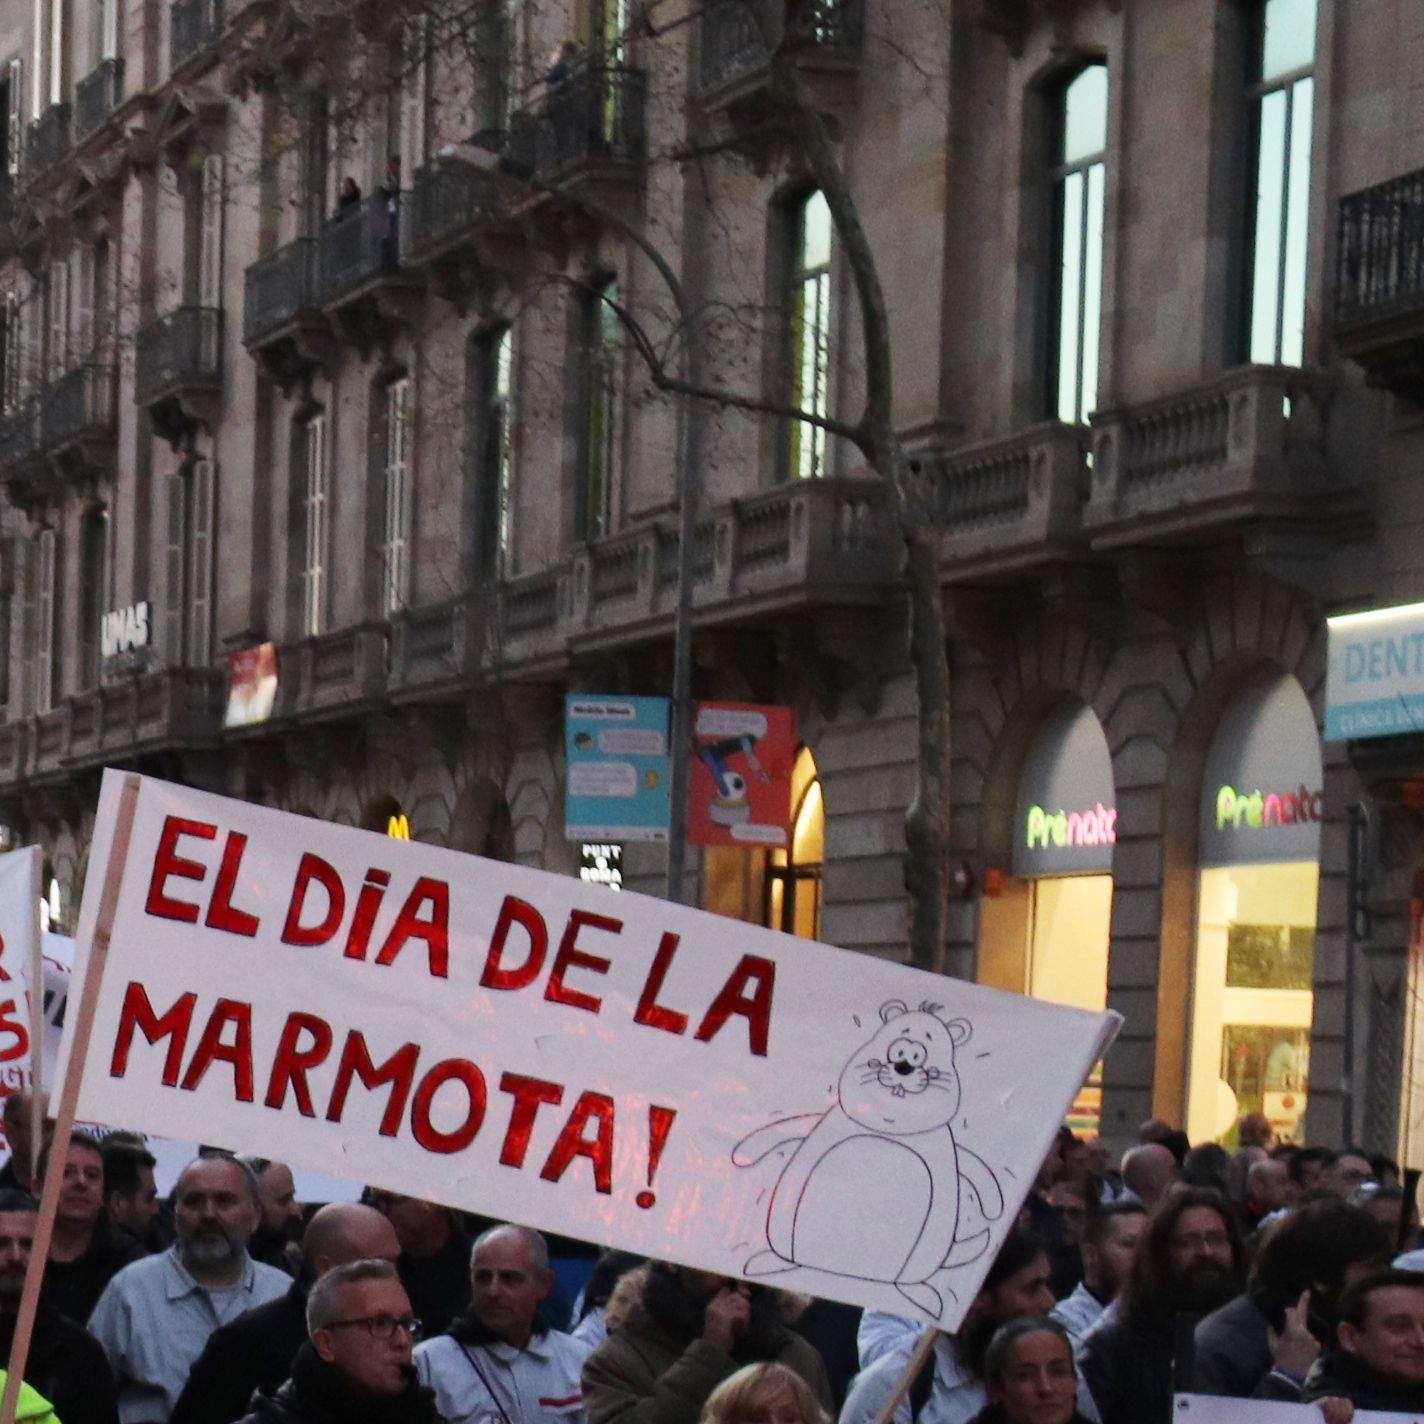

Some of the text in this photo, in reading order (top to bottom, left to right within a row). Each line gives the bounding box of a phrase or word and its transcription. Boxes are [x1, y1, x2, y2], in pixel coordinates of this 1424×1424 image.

[144, 815, 260, 938] EL
[479, 894, 624, 1013] DE
[631, 931, 777, 1057] LA
[109, 981, 678, 1210] MARMOTA!
